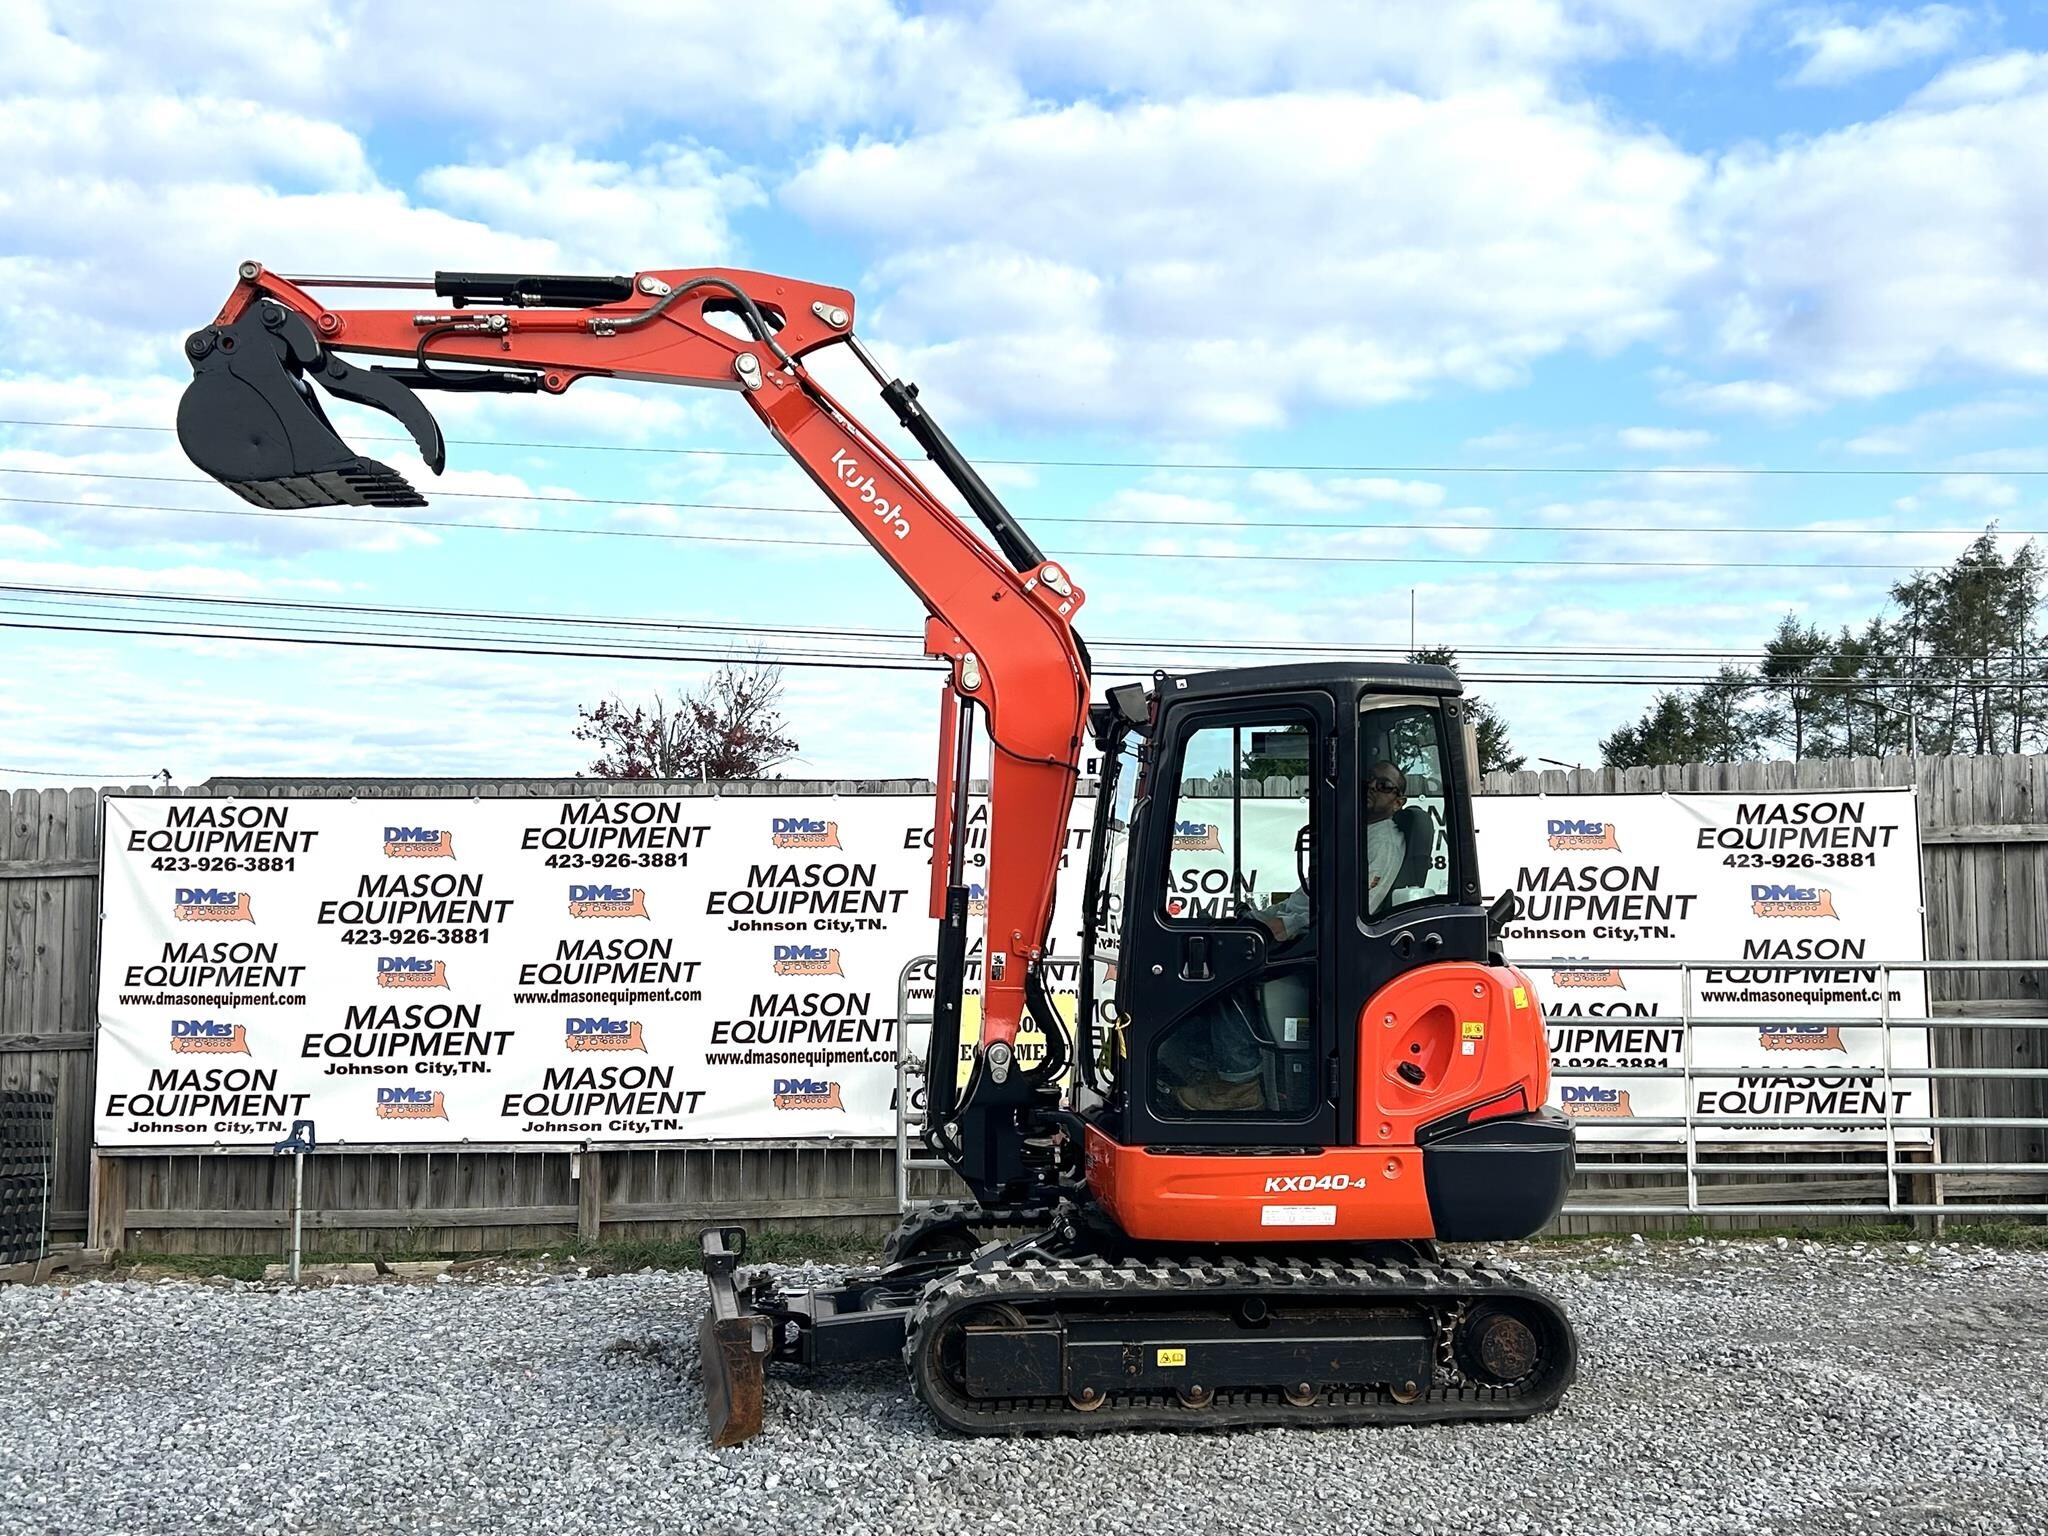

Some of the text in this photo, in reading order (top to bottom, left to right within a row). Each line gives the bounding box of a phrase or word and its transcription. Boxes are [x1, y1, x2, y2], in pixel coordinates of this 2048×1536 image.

[831, 447, 910, 540] Kubota
[166, 806, 288, 828] MASON
[560, 802, 681, 824] MASON
[1736, 802, 1864, 824] MASON
[127, 830, 318, 852] EQUIPMENT
[521, 826, 711, 849] EQUIPMENT
[1697, 826, 1898, 849] EQUIPMENT
[151, 857, 294, 871] 423-926-3881
[545, 853, 687, 868] 423-926-3881
[1723, 853, 1875, 868] 423-926-3881
[357, 874, 483, 897] MASON
[747, 864, 876, 887] MASON
[1517, 866, 1659, 892] MASON
[318, 900, 514, 924] EQUIPMENT
[706, 890, 908, 914] EQUIPMENT
[341, 928, 488, 944] 423-926-3881
[728, 920, 807, 931] Johnson
[1499, 927, 1585, 939] Johnson
[162, 943, 278, 963] MASON
[556, 939, 672, 960] MASON
[1743, 939, 1865, 959] MASON
[125, 966, 306, 987] EQUIPMENT
[519, 962, 701, 985] EQUIPMENT
[1705, 969, 1876, 984] EQUIPMEN
[119, 992, 306, 1008] www.dmasonequipment.com
[514, 988, 701, 1005] www.dmasonequipment.com
[749, 993, 870, 1017] MASON
[1701, 988, 1901, 1005] www.dmasonequipment.cm
[345, 1004, 481, 1029] MASON
[711, 1019, 897, 1044] EQUIPMENT
[1550, 1029, 1684, 1053] UIPMENT
[301, 1031, 515, 1057] EQUIPMENT
[148, 1069, 277, 1091] MASON
[324, 1063, 408, 1075] Johnson
[543, 1066, 674, 1090] MASON
[106, 1094, 310, 1117] EQUIPMENT
[501, 1091, 706, 1116] EQUIPMENT
[1697, 1091, 1911, 1114] EQUIPMENT
[128, 1122, 207, 1132] Johnson
[522, 1122, 601, 1132] Johnson
[1264, 1174, 1367, 1193] KX040-4
